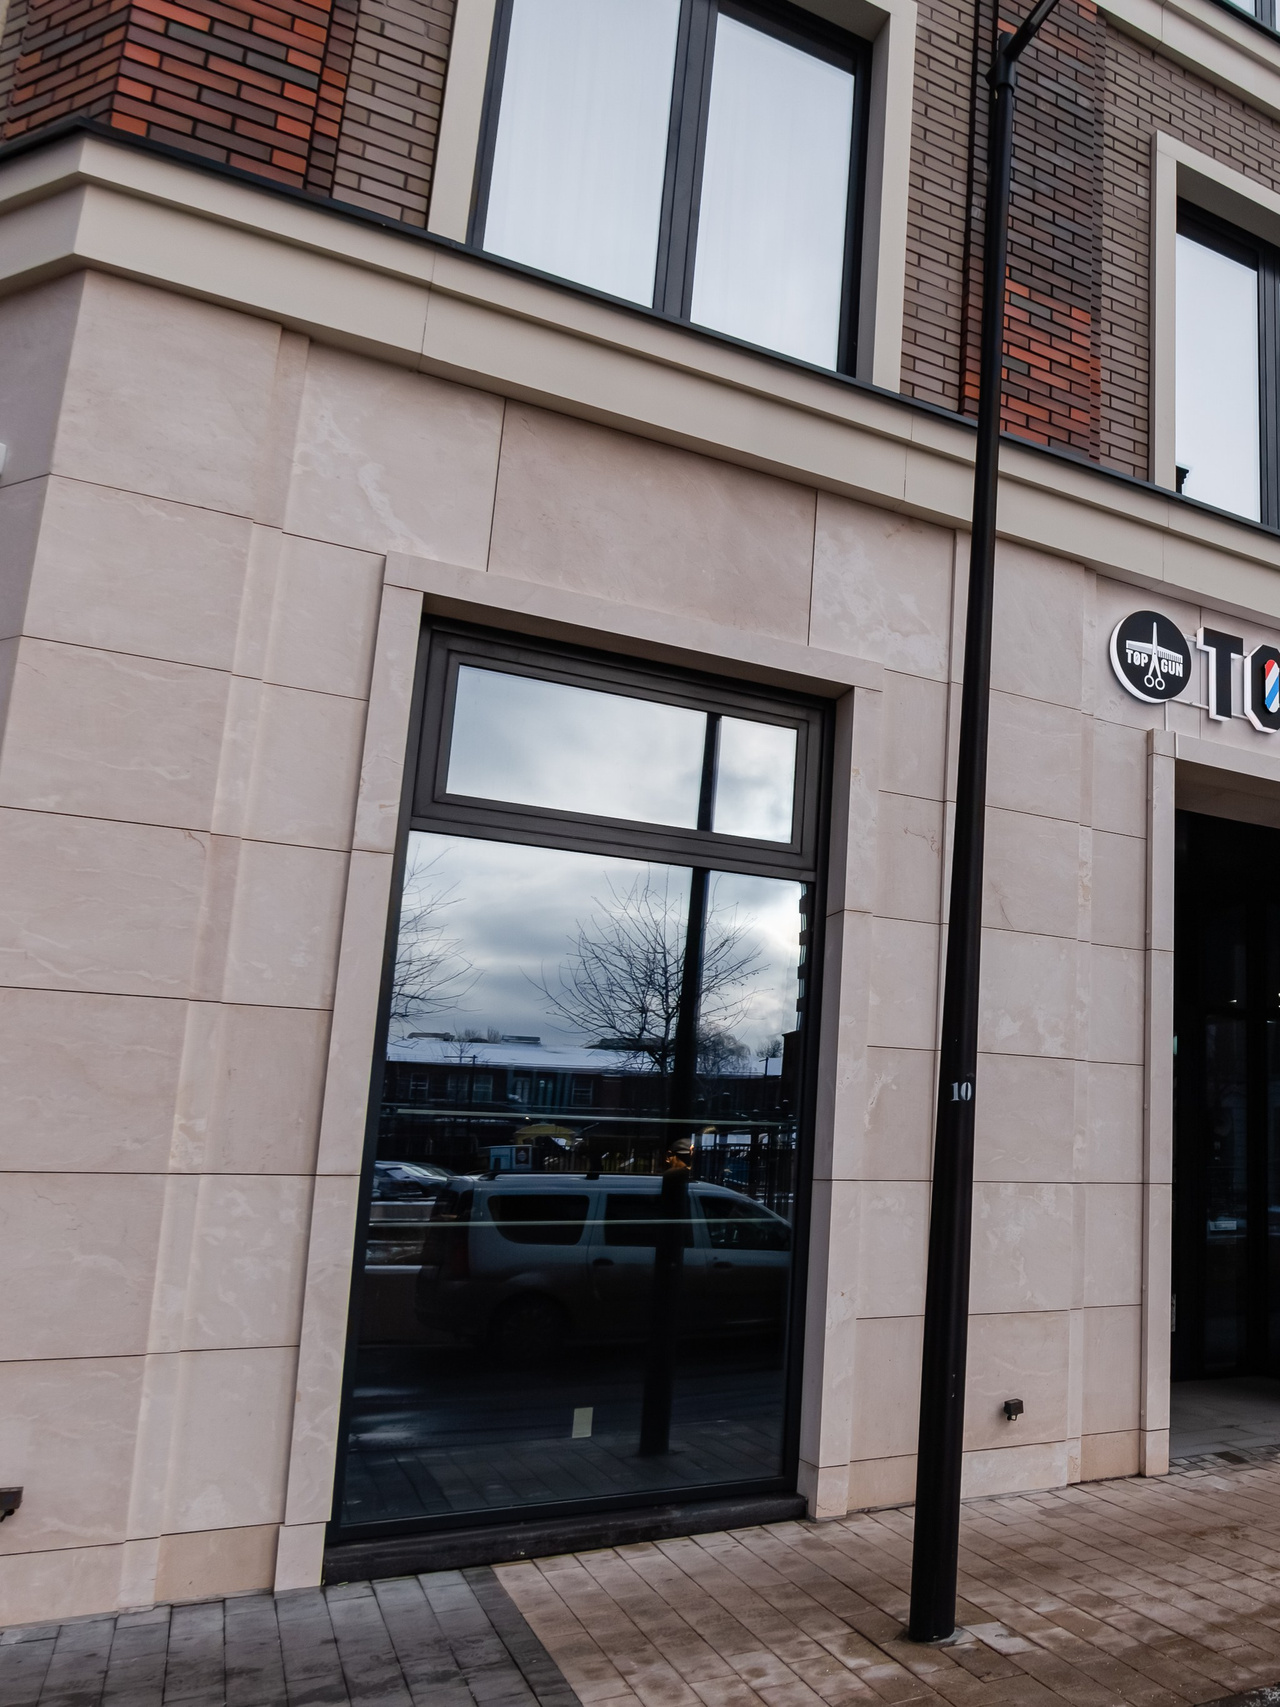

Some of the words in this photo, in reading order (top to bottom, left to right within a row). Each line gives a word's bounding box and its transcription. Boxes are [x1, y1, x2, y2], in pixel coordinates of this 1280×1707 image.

[1126, 648, 1148, 668] TOP
[1160, 657, 1183, 678] GUN
[950, 1081, 972, 1102] 10
